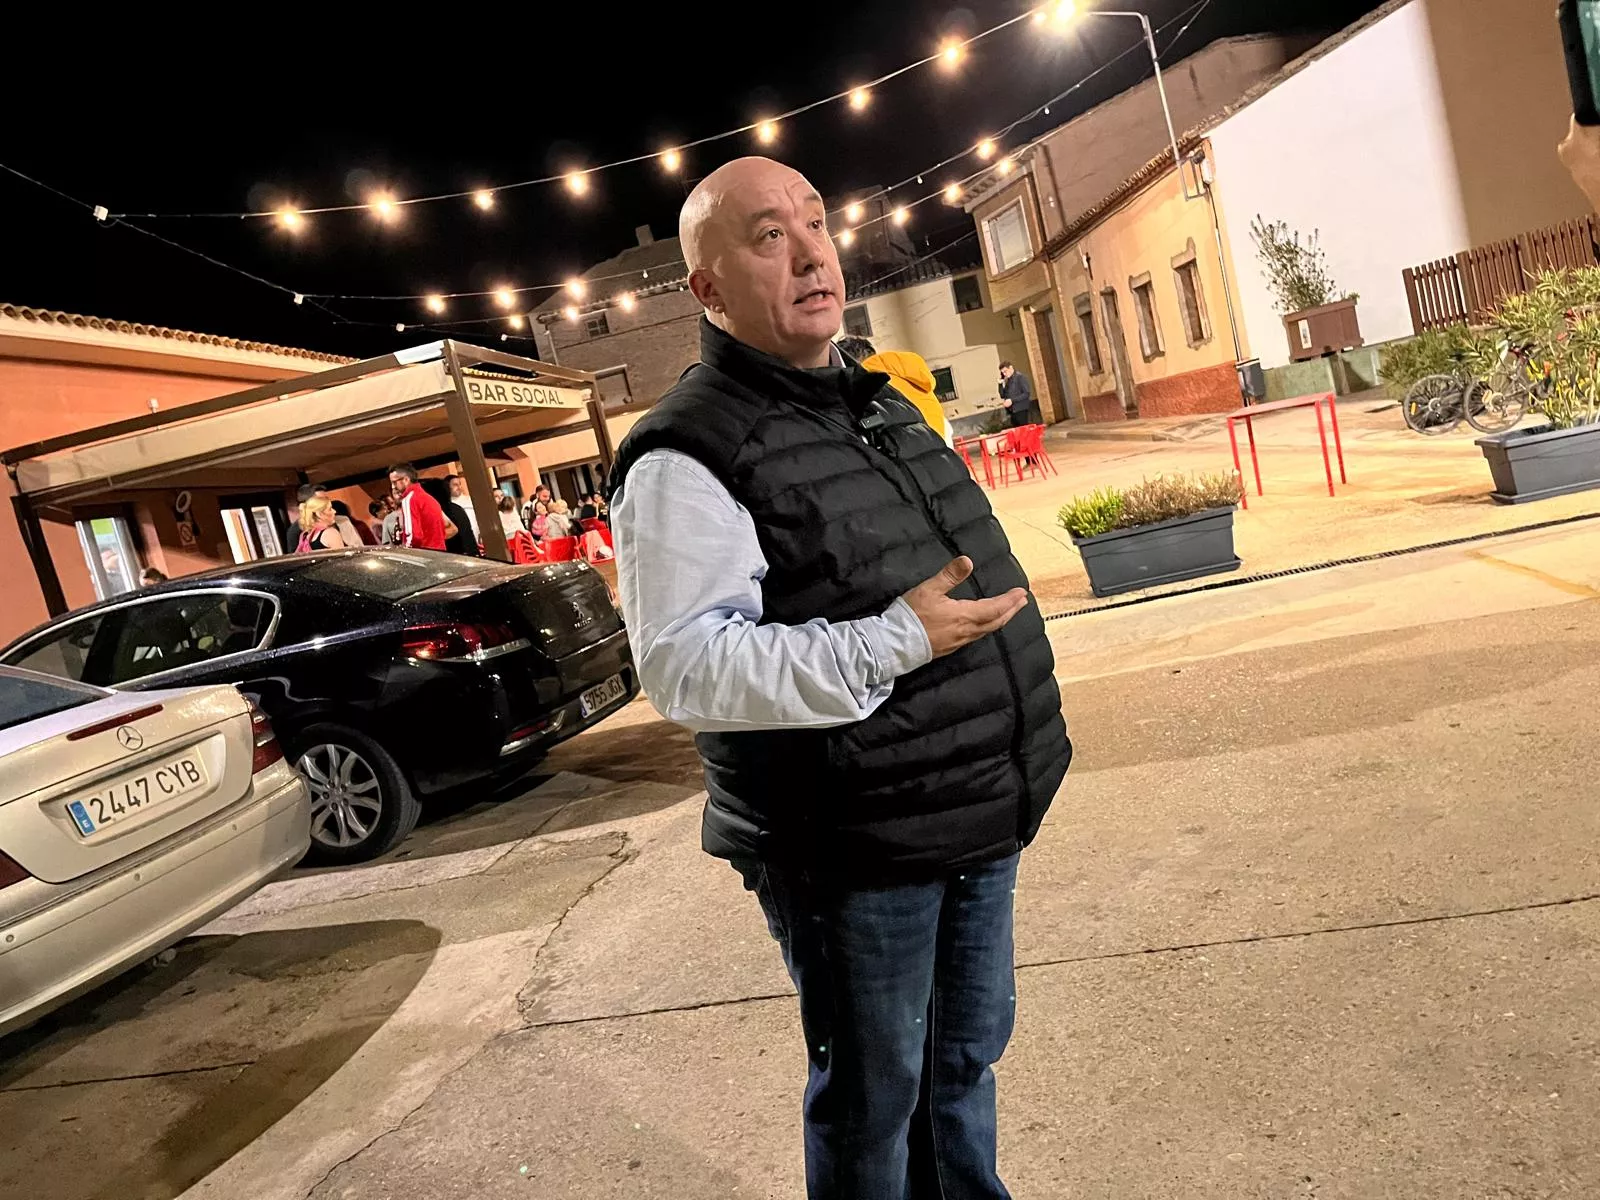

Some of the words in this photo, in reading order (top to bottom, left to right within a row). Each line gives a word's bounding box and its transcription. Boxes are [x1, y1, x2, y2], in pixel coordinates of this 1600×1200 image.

[469, 382, 508, 402] BAR
[511, 386, 564, 405] SOCIAL
[90, 777, 150, 824] 2447
[156, 760, 200, 794] CYB
